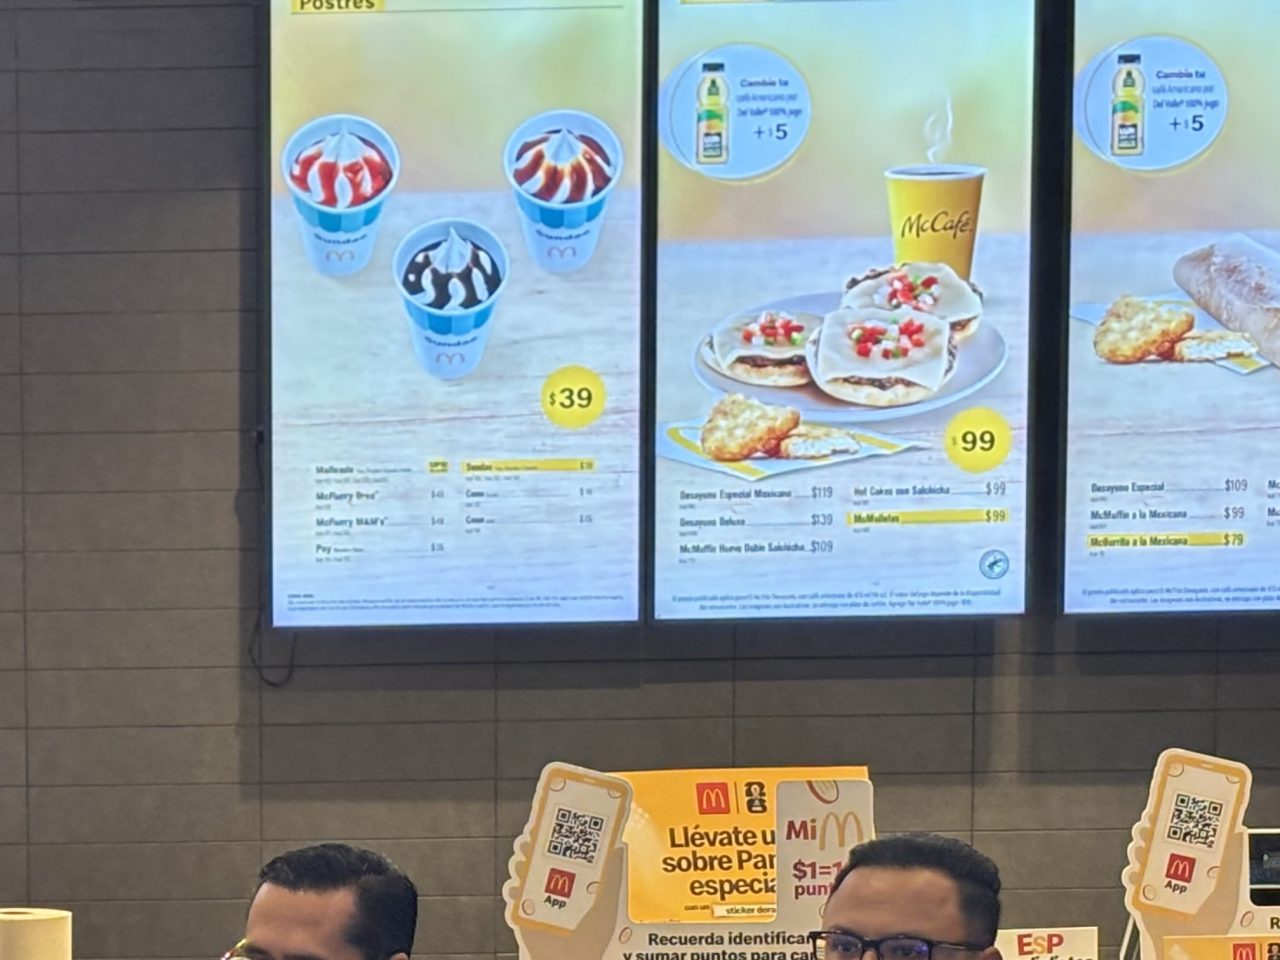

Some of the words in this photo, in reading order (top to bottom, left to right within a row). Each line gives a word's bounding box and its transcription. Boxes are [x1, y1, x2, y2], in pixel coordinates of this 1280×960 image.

[300, 0, 376, 10] Postres
[901, 210, 973, 239] McCafé
[549, 387, 593, 409] $39
[811, 486, 833, 499] $119
[985, 482, 1006, 496] $99
[1131, 482, 1165, 492] Especial
[1224, 479, 1248, 491] $109
[316, 492, 354, 501] McFlurry
[985, 509, 1006, 522] $99
[1224, 507, 1245, 519] $99
[316, 518, 354, 528] McFlurry
[810, 540, 833, 554] $109
[1223, 534, 1244, 546] $79
[669, 825, 758, 849] Llévate
[761, 829, 776, 846] u
[662, 851, 733, 873] sobre
[689, 871, 776, 901] especia
[1165, 881, 1187, 895] App
[543, 894, 567, 910] App
[757, 904, 776, 914] dora
[648, 932, 724, 946] Recuerda
[1017, 933, 1064, 956] ESP
